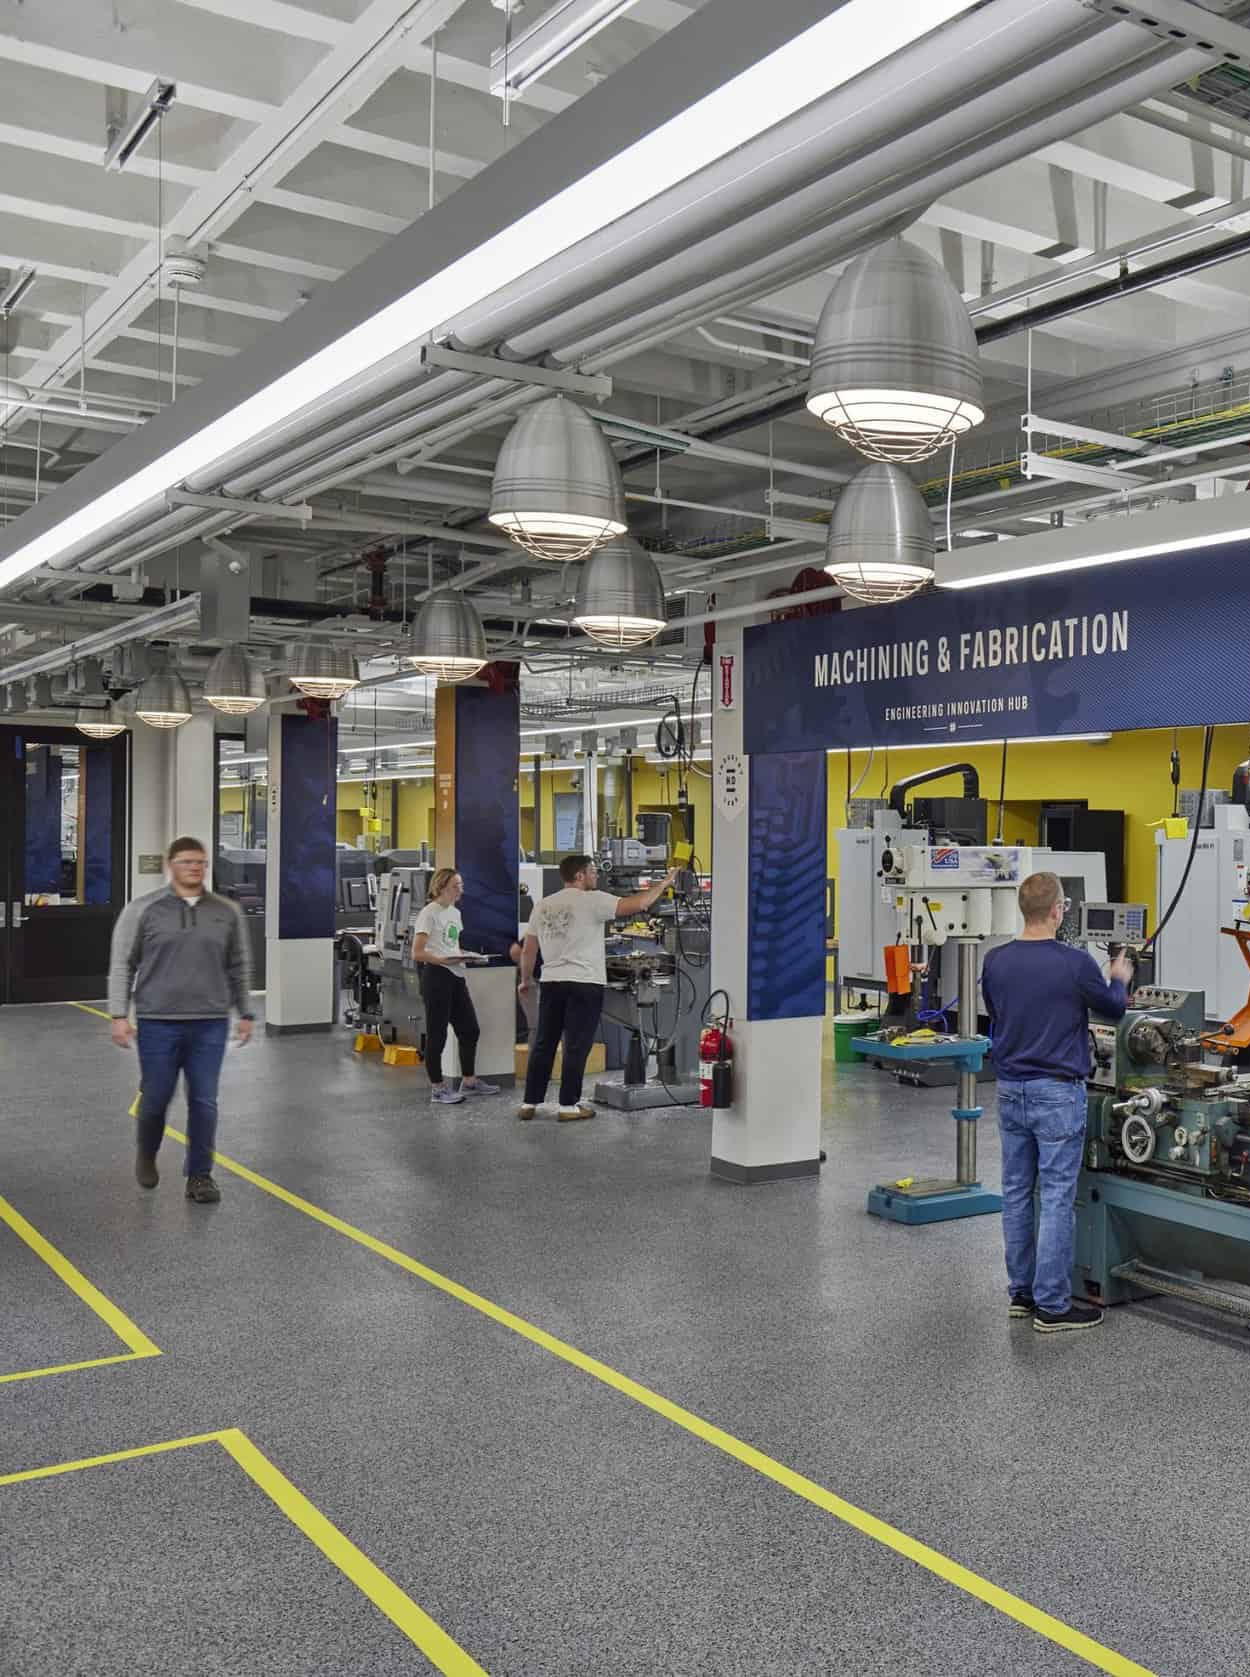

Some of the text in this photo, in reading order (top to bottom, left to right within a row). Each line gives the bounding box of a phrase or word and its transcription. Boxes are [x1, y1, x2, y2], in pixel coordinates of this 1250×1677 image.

[814, 610, 1128, 687] MACHINING & FABRICATION
[885, 695, 1029, 721] ENGINEERING INNOVATION HUB
